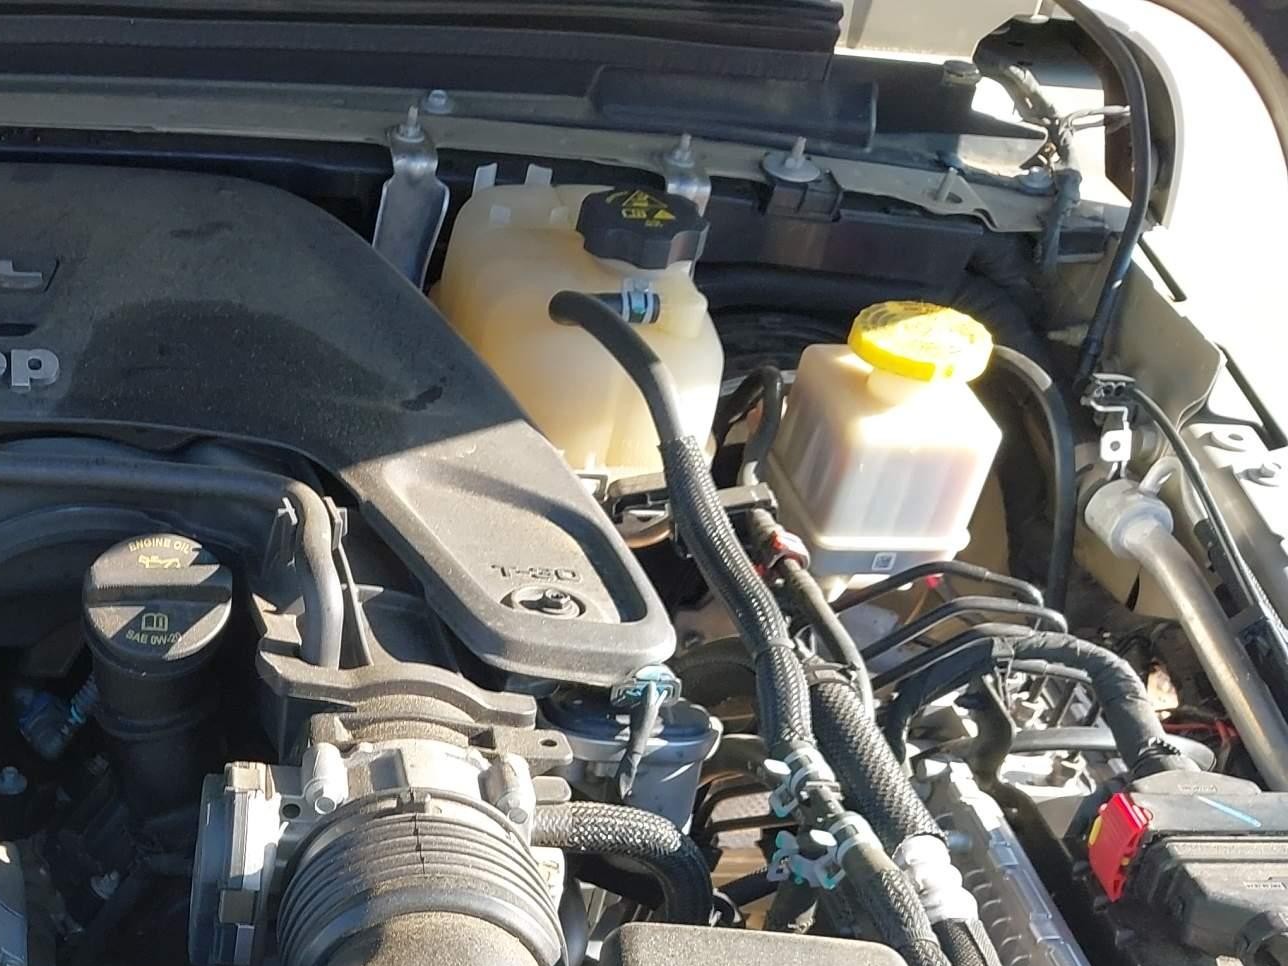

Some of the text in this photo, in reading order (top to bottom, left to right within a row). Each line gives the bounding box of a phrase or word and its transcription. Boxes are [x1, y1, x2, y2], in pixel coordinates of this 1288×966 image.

[128, 537, 190, 554] ENGINE OIL
[125, 629, 148, 644] SAE
